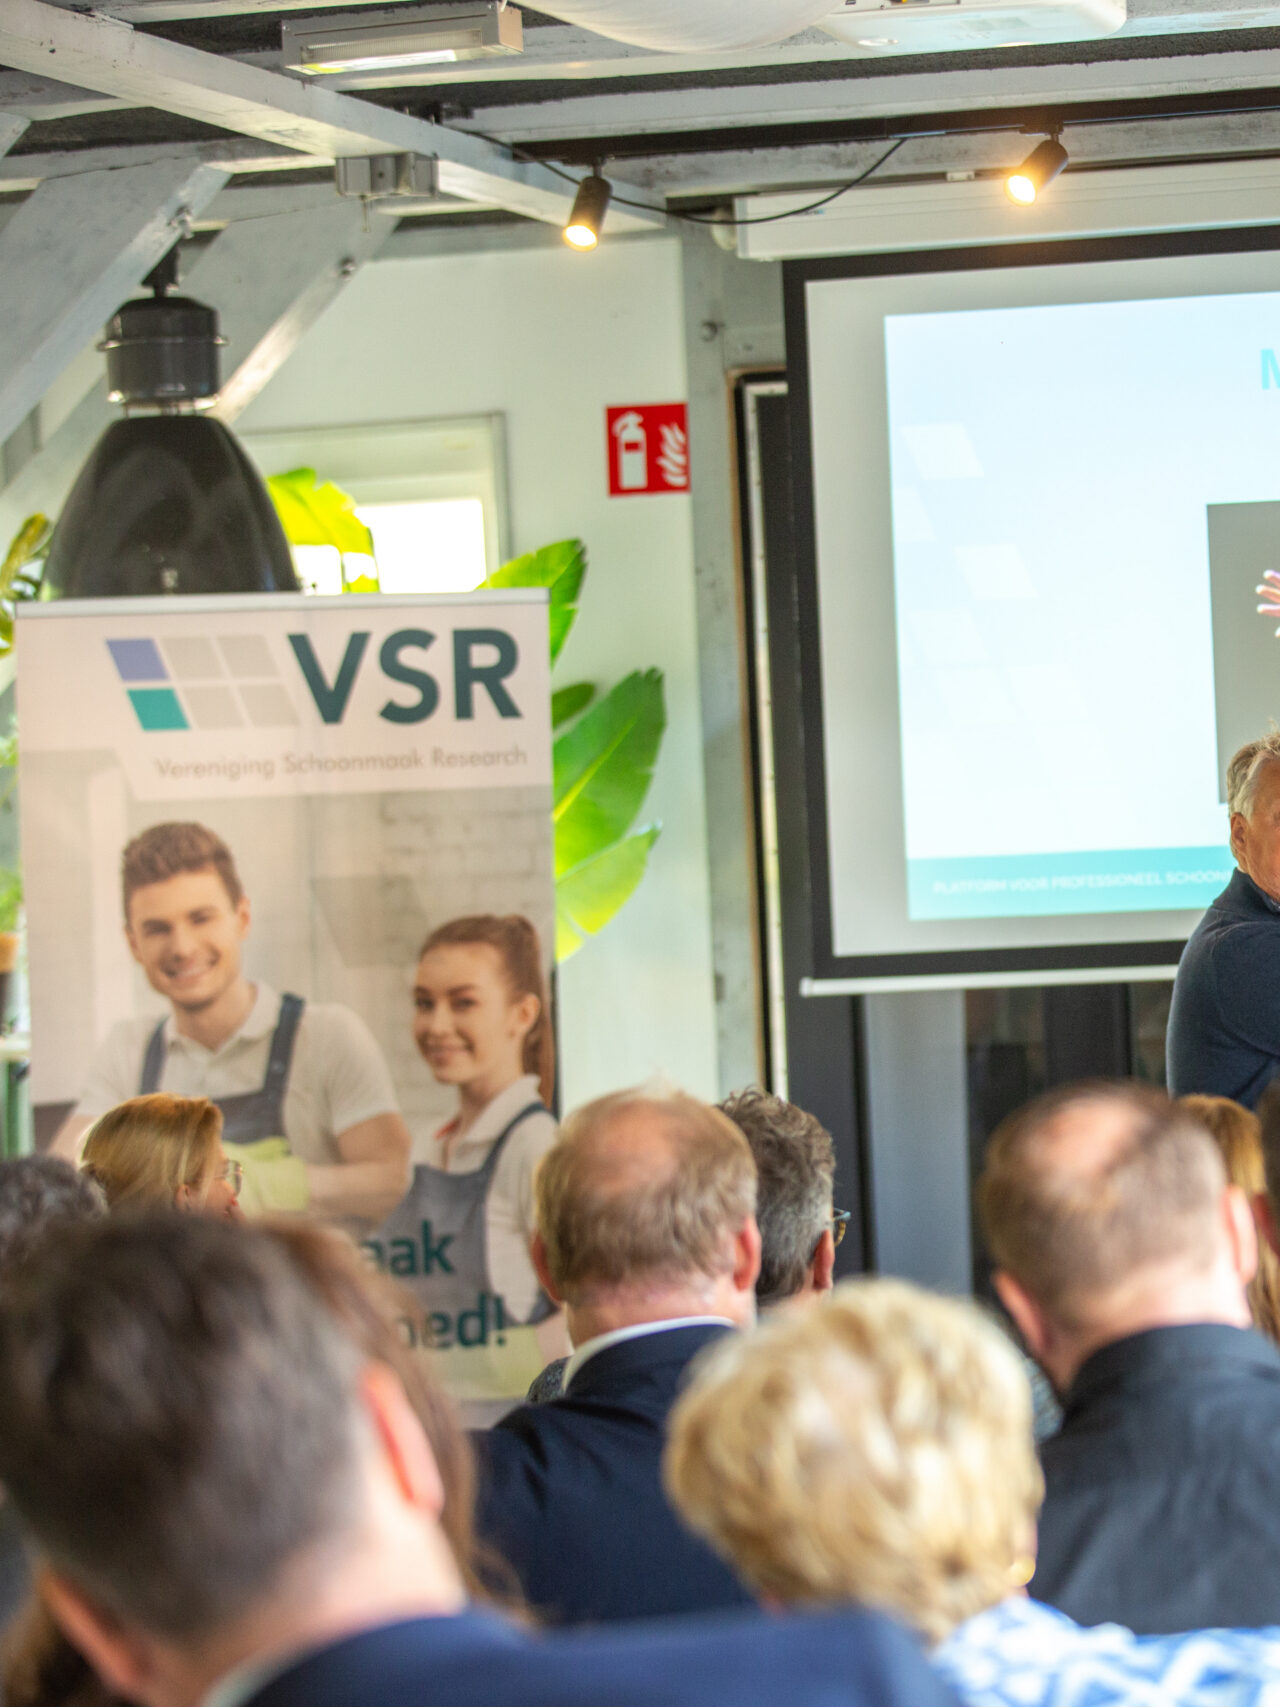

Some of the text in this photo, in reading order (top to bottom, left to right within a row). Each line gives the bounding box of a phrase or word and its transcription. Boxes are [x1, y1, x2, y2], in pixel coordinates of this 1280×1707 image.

[287, 627, 523, 725] VSR
[155, 745, 528, 782] Vereniging Schoonmaak Research
[932, 880, 1007, 895] PLATFORM
[1009, 877, 1049, 891] VOOR
[1051, 872, 1162, 889] PROFESSIONEEL
